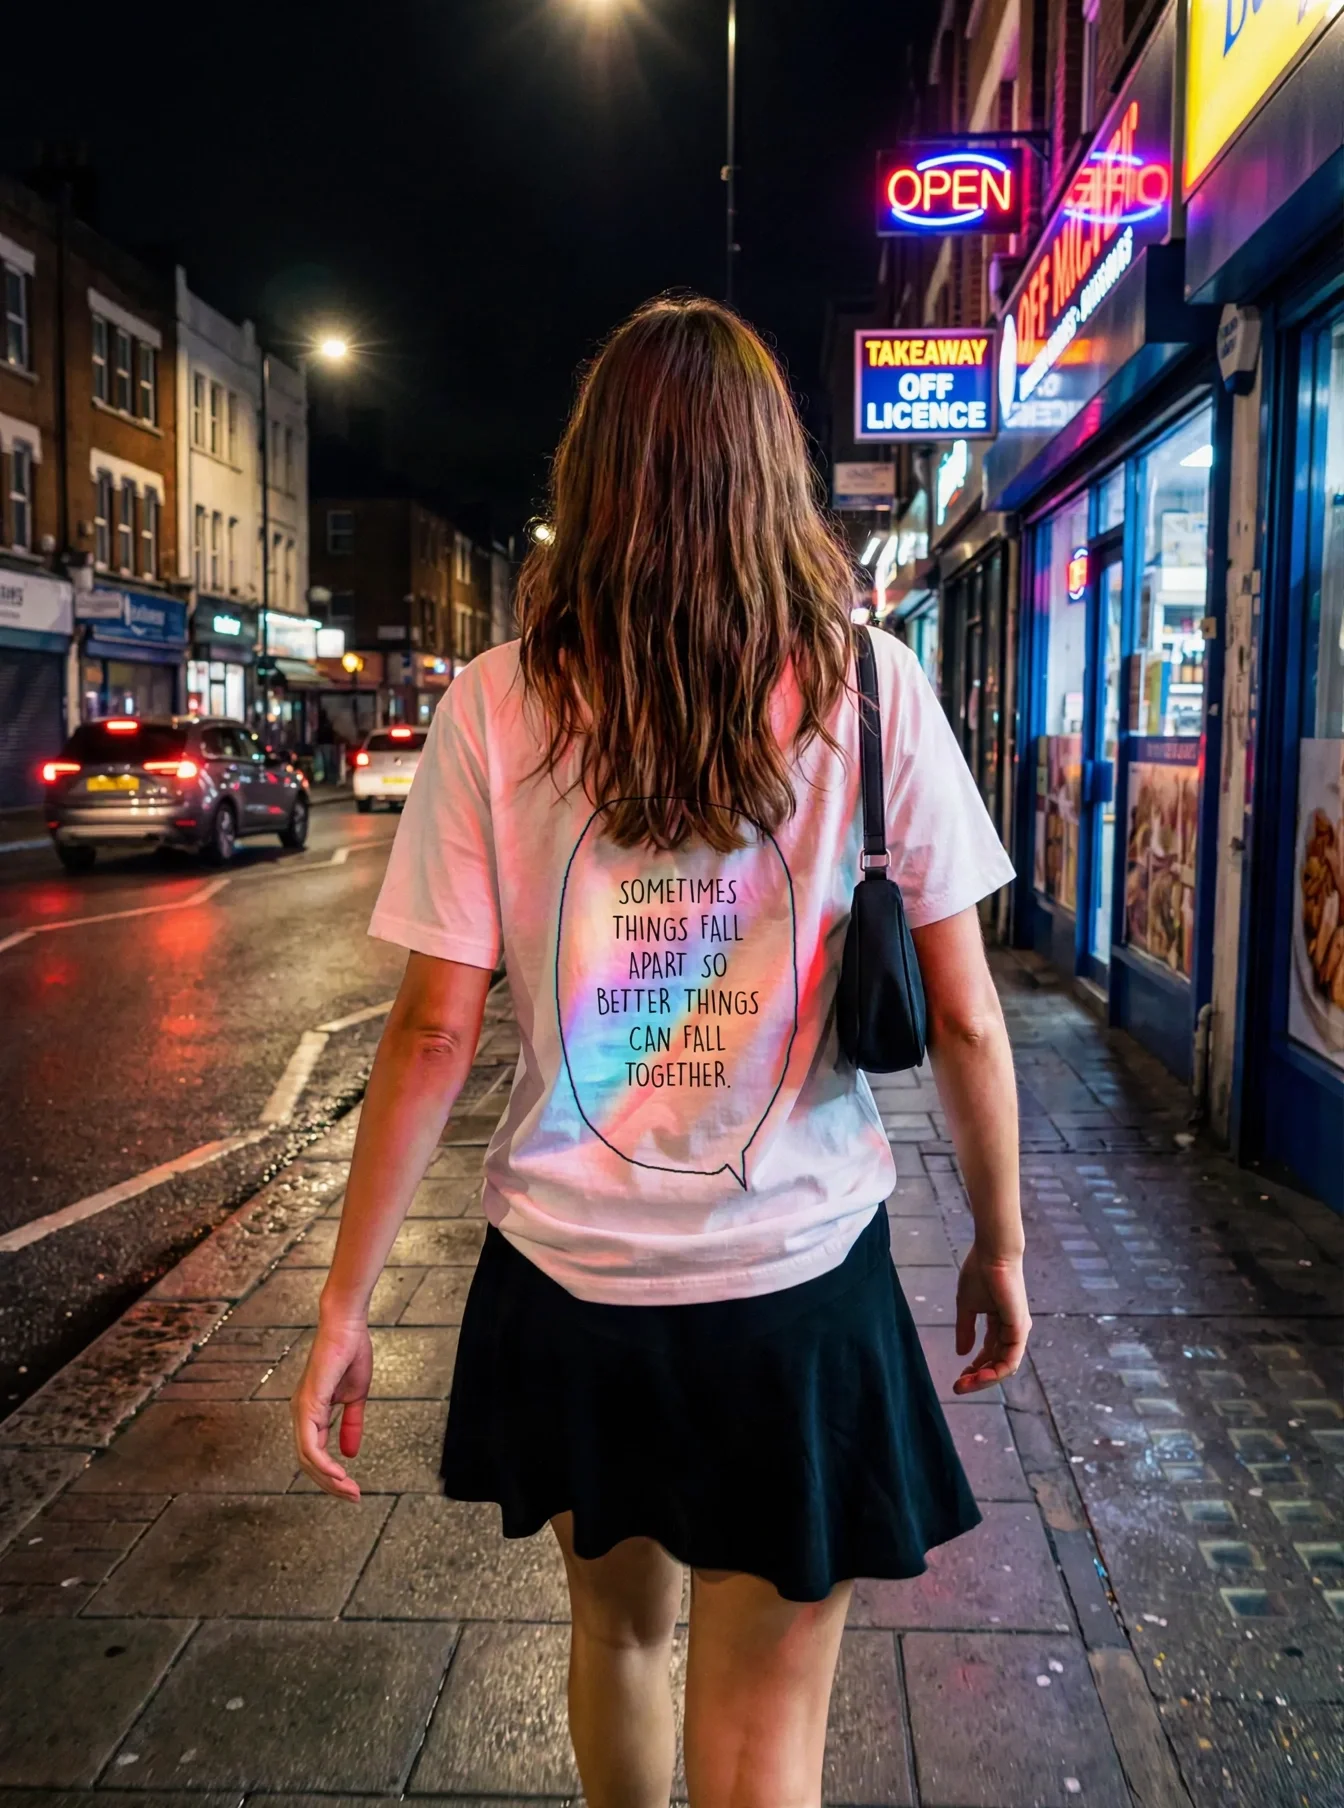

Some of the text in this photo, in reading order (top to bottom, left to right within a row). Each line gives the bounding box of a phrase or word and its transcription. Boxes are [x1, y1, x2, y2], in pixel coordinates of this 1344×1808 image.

[887, 169, 1012, 212] OPEN
[865, 339, 988, 367] TAKEAWAY
[898, 372, 955, 401] OFF
[866, 401, 987, 430] LICENCE
[618, 877, 738, 905] SOMETIMES
[612, 914, 744, 942] THINGS FALL
[629, 951, 728, 980] APART SO
[596, 987, 760, 1016] BETTER THINGS
[628, 1024, 727, 1053] CAN FALL
[624, 1060, 732, 1089] TOGETHER.
